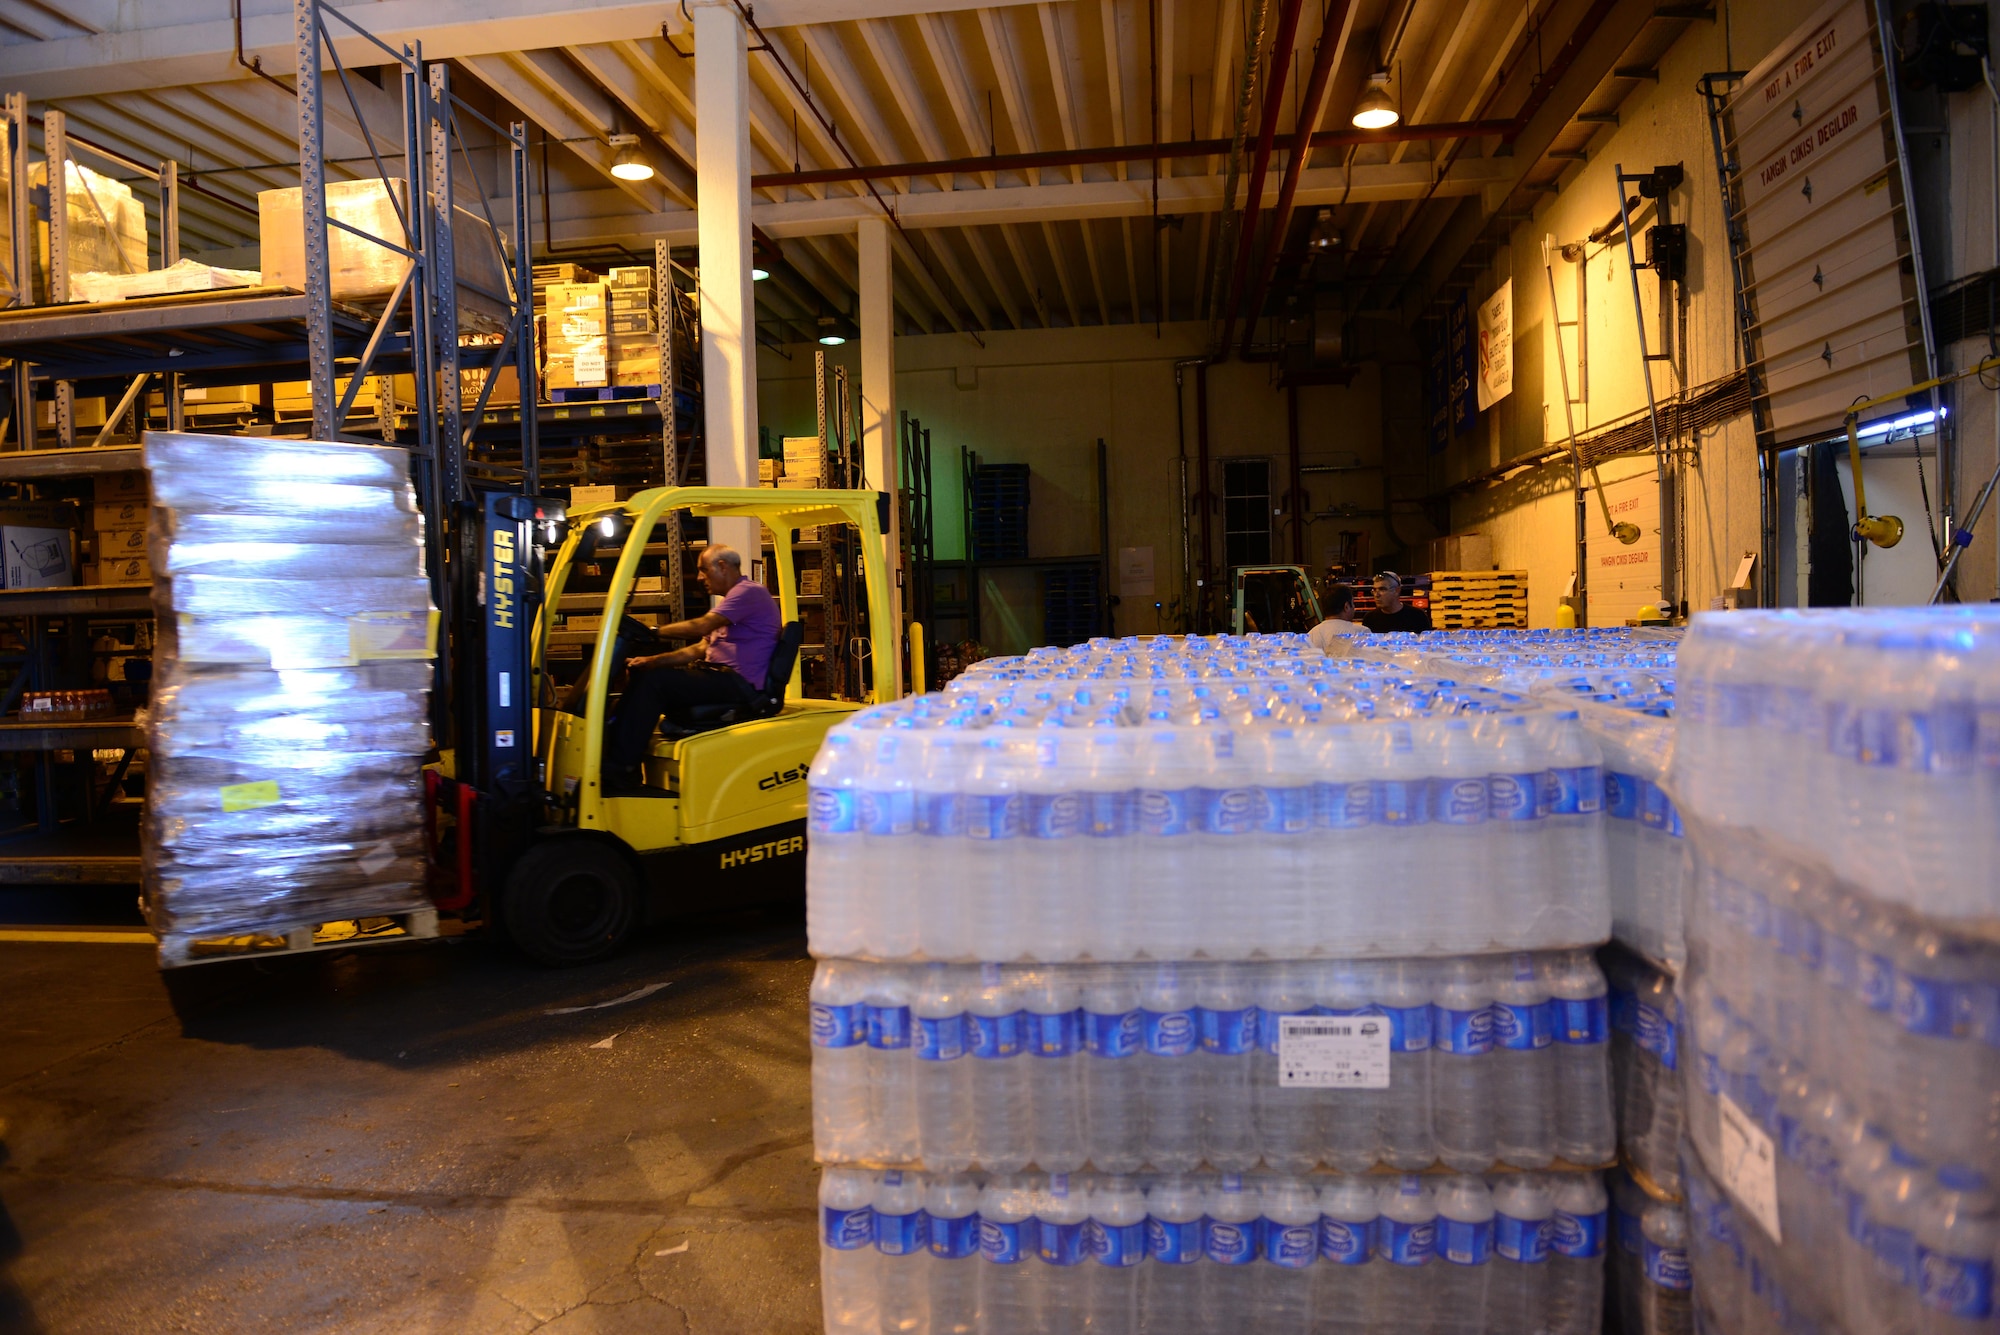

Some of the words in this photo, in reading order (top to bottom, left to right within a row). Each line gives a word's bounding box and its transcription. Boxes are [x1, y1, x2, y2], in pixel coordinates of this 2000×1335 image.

[1765, 77, 1781, 103] NOT
[1785, 71, 1792, 89] A
[1793, 51, 1814, 80] FIRE
[1816, 29, 1836, 60] EXIT
[1760, 155, 1788, 187] YANGIN
[1790, 135, 1814, 165] CIKISI
[1817, 105, 1858, 147] DEGILDIR
[493, 529, 515, 629] HYSTER
[720, 836, 804, 870] HYSTER
